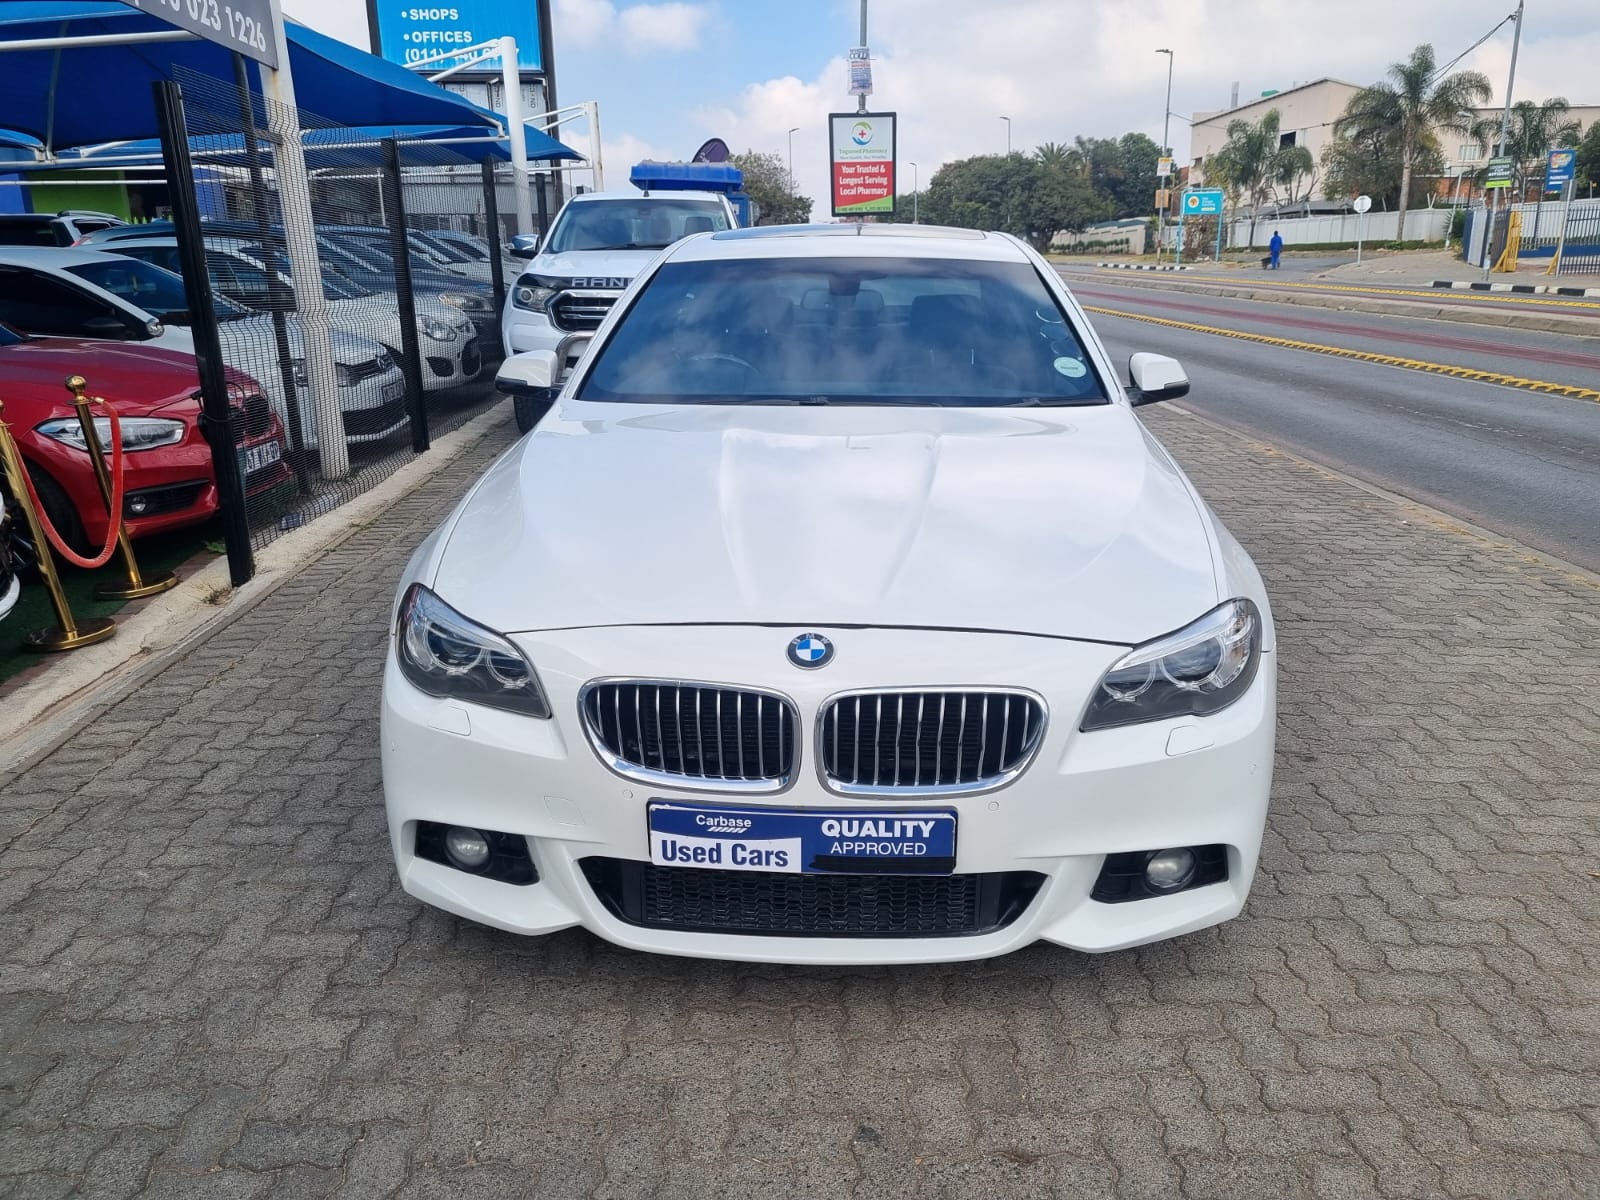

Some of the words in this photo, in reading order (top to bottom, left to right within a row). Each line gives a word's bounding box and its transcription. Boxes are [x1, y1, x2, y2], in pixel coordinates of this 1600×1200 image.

[410, 9, 459, 20] SHOPS
[186, 0, 222, 31] 023
[225, 6, 266, 52] 1226
[412, 31, 473, 43] OFFICES
[405, 47, 444, 64] (011)
[841, 165, 855, 173] Your
[856, 165, 879, 173] Trusted
[840, 176, 863, 185] Longest
[864, 176, 887, 185] Serving
[840, 187, 856, 195] Local
[857, 187, 887, 196] Pharmacy
[696, 814, 752, 828] Carbase
[821, 819, 936, 839] QUALITY
[661, 839, 722, 864] Used
[731, 843, 789, 868] Cars
[830, 841, 927, 856] APPROVED
